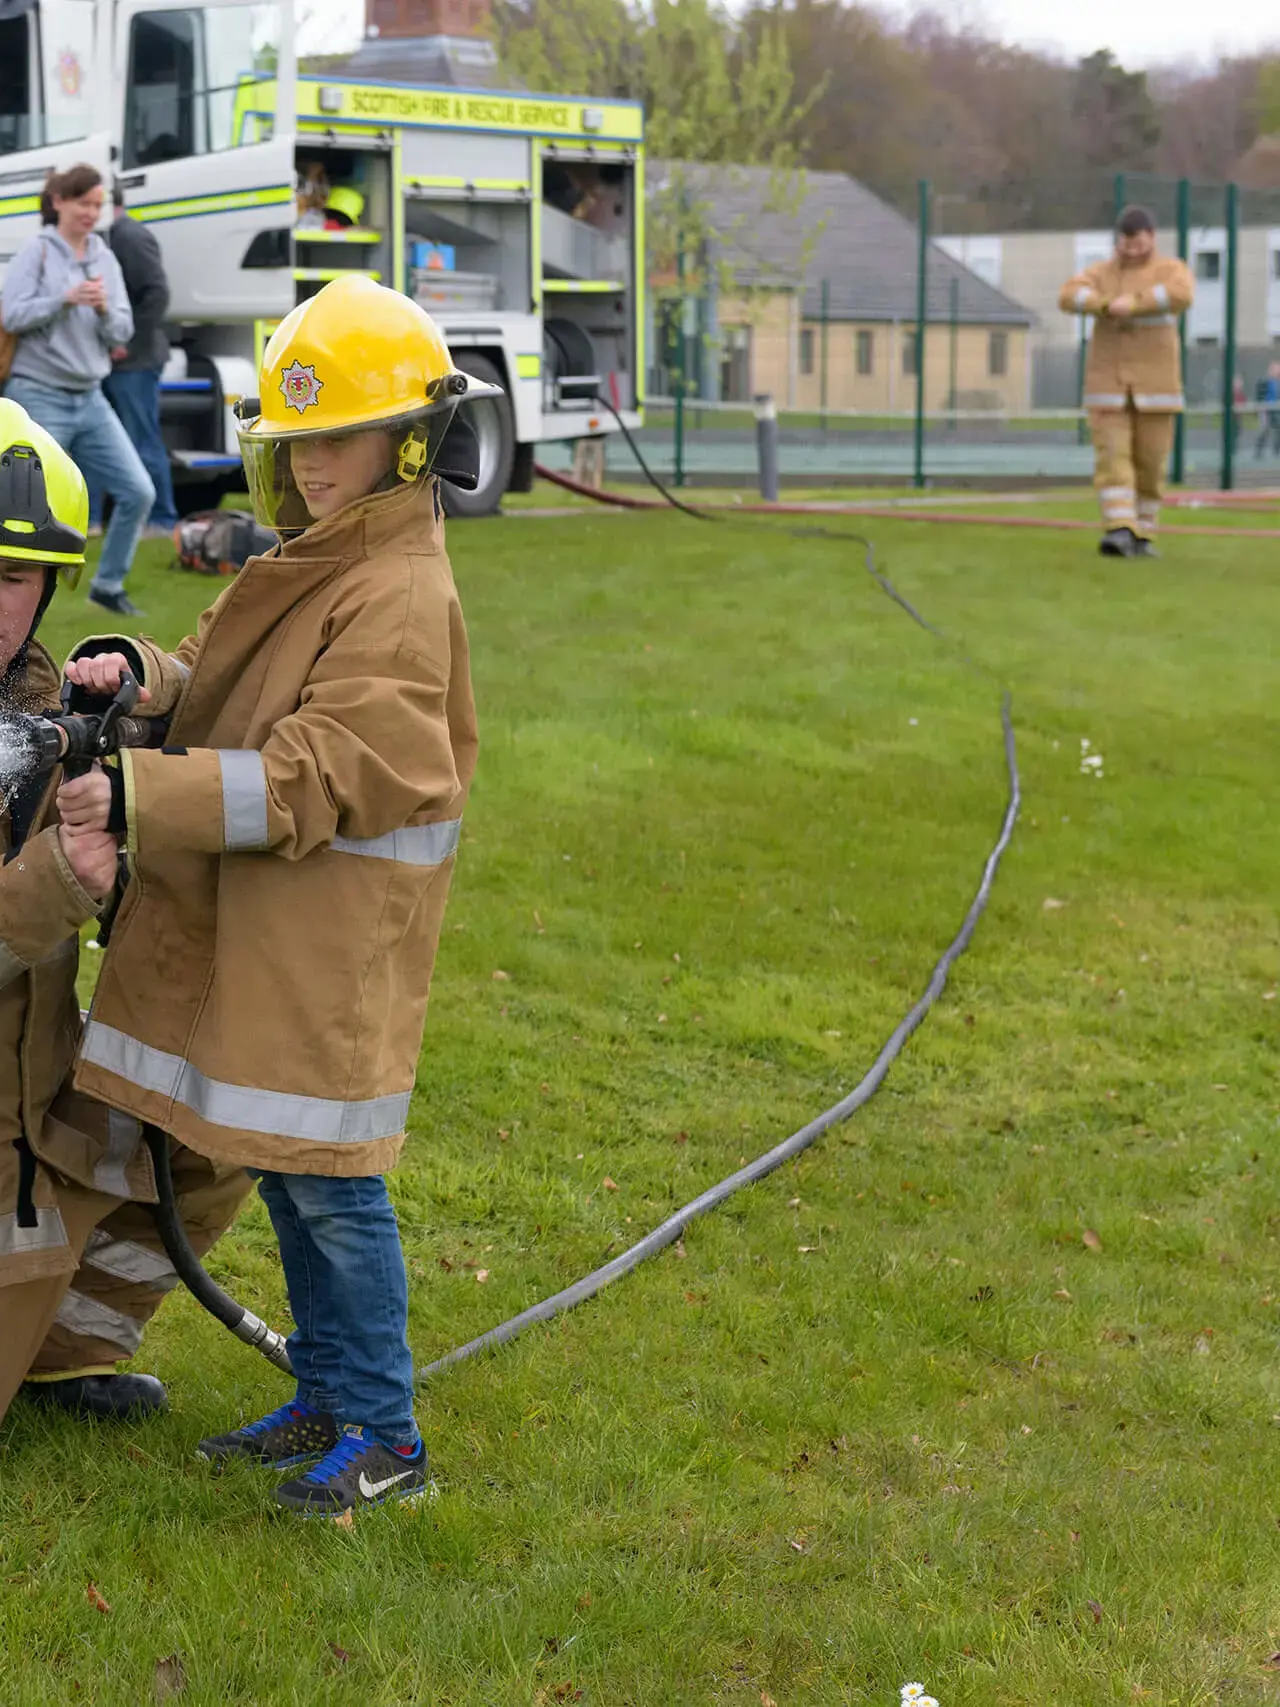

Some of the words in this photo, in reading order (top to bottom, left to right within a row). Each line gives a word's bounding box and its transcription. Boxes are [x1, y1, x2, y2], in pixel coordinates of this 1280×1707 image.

[352, 91, 418, 115] SCOTTISH
[422, 96, 450, 119] FIRE
[454, 100, 464, 120] &
[467, 101, 515, 124] RESCUE
[519, 104, 569, 127] SERVICE
